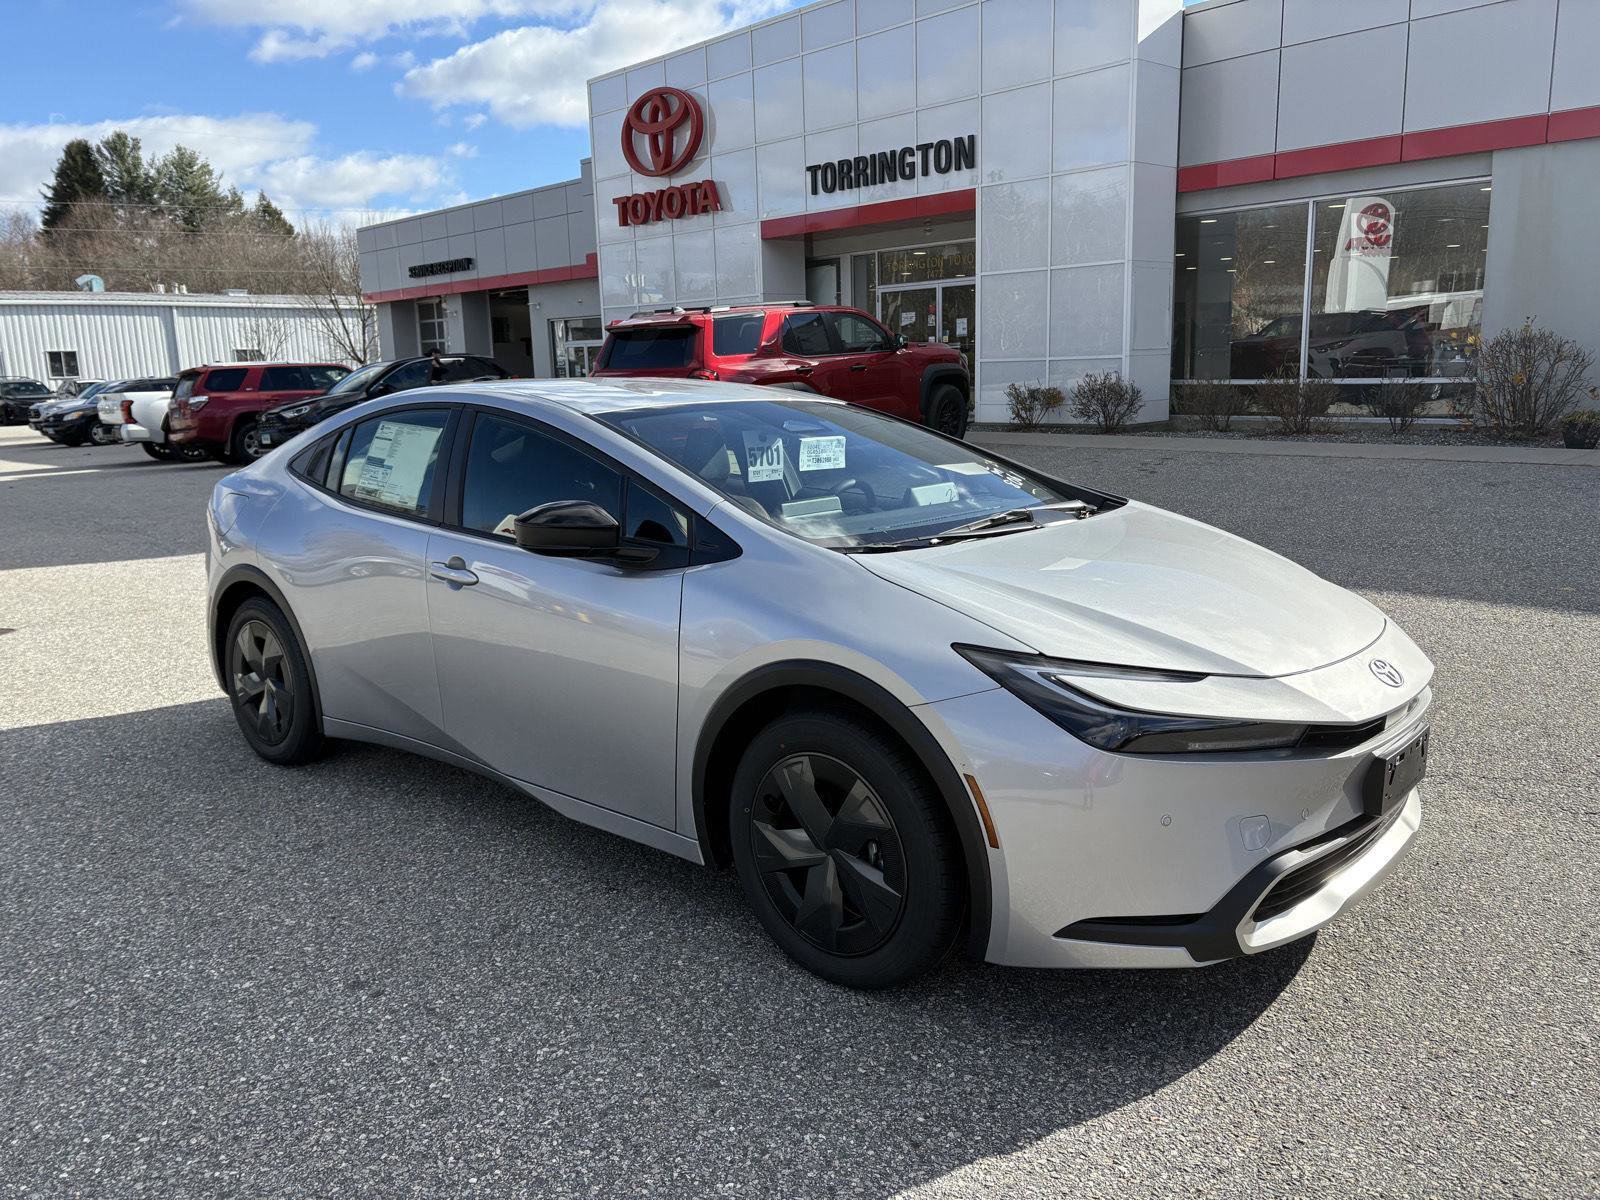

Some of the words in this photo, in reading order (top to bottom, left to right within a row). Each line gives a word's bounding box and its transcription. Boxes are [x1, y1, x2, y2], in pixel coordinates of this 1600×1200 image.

[806, 134, 976, 195] TORRINGTON
[612, 179, 722, 227] TOYOTA
[948, 254, 974, 265] TOYO
[748, 445, 781, 468] 5701
